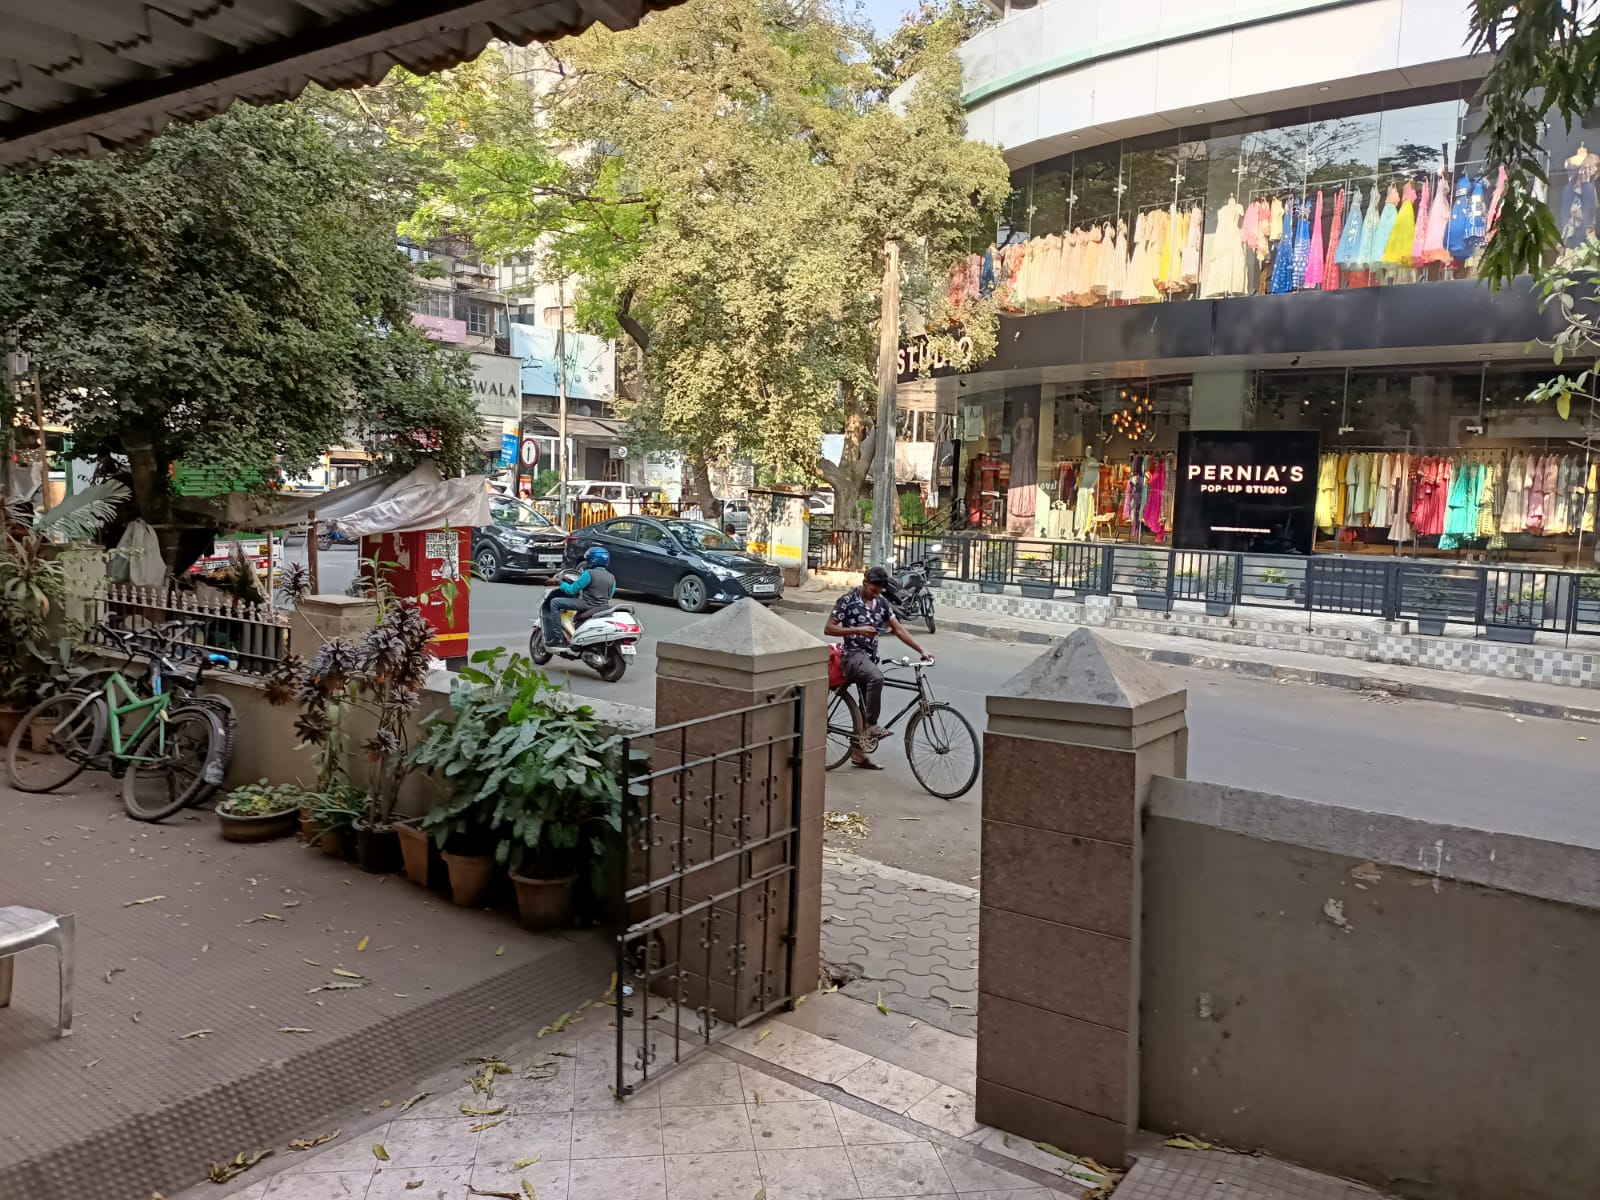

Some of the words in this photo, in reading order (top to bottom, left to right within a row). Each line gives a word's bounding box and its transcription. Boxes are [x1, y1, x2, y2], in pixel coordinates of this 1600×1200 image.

[897, 337, 972, 375] STUDO
[1188, 465, 1304, 482] PERNIA'S
[1200, 485, 1242, 493] POP-UP
[1245, 485, 1288, 494] STUDIO
